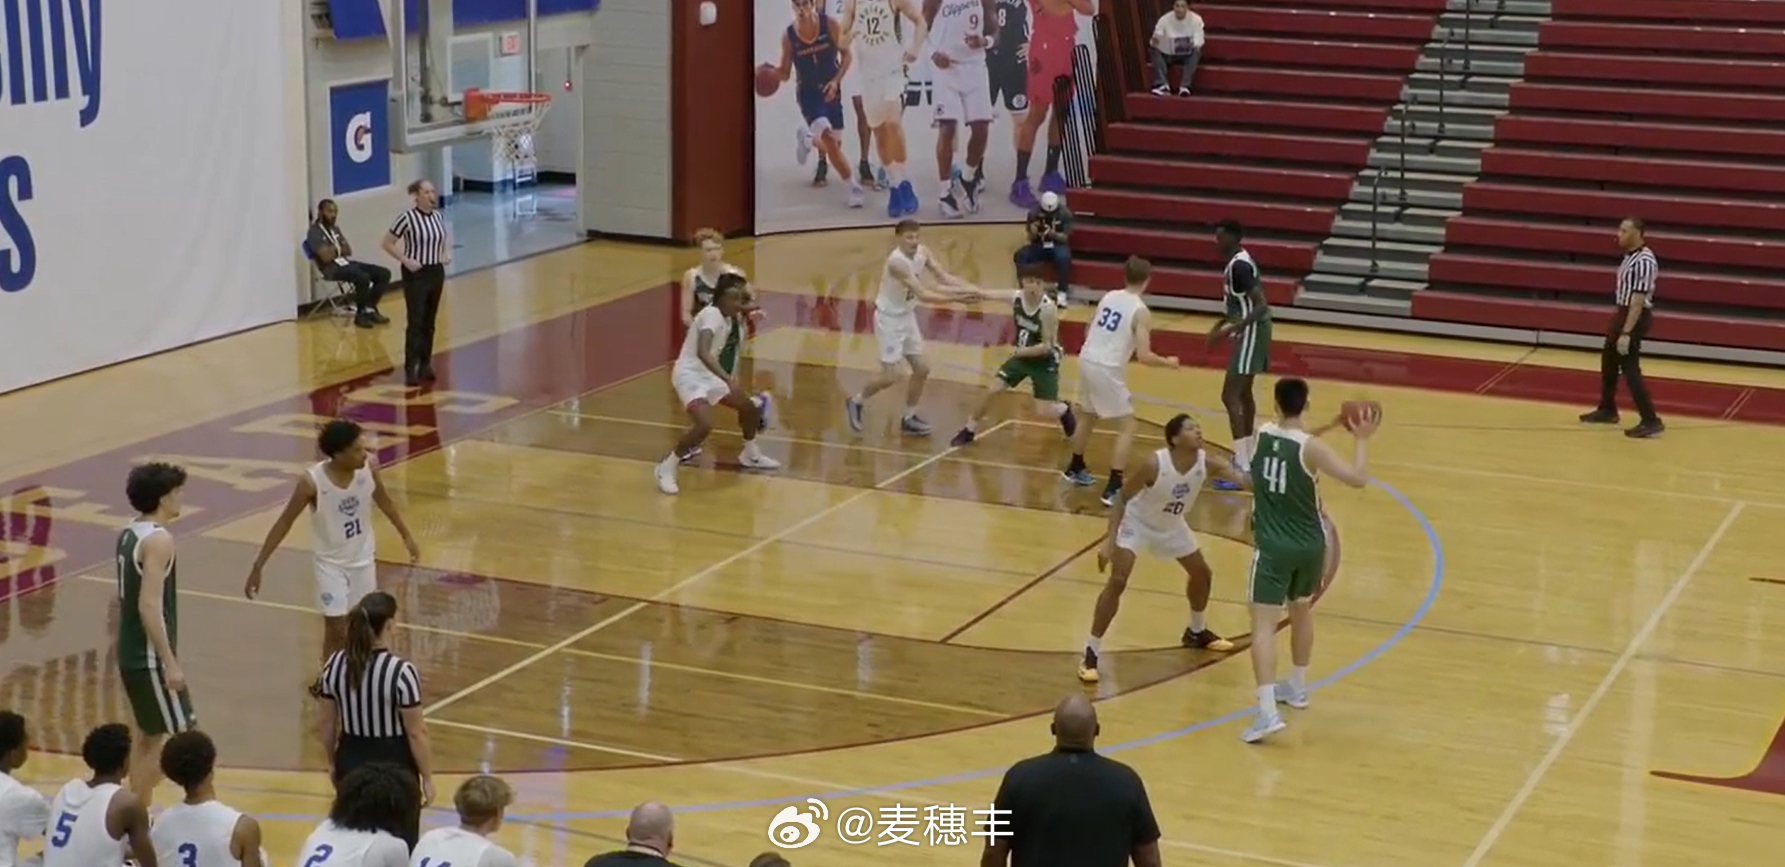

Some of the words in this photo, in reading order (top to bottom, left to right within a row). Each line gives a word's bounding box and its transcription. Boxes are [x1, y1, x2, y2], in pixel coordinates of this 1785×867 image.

[867, 17, 881, 35] 12
[969, 14, 978, 30] 9
[998, 8, 1006, 27] 8
[345, 111, 372, 163] G
[1097, 307, 1122, 332] 33
[1263, 456, 1287, 495] 41
[344, 518, 362, 539] 21
[51, 811, 78, 848] 5
